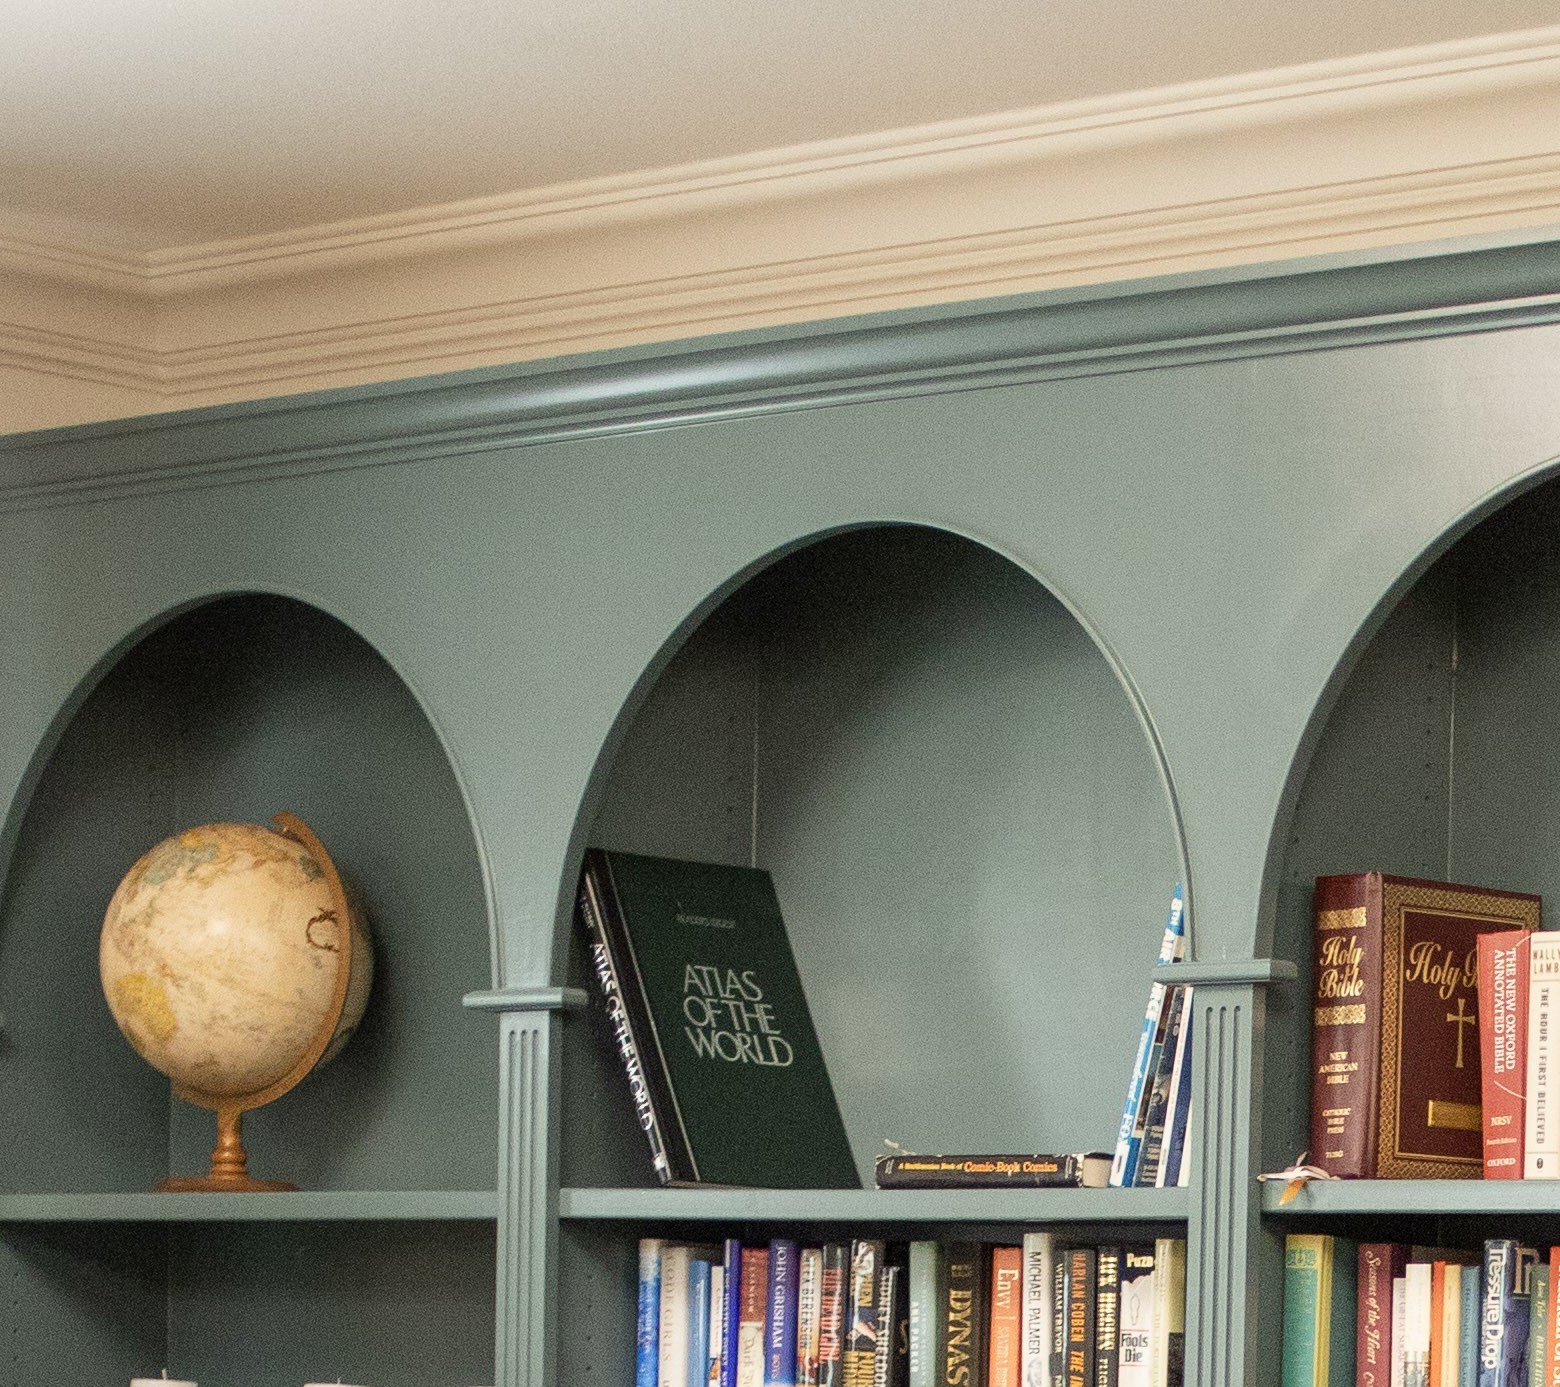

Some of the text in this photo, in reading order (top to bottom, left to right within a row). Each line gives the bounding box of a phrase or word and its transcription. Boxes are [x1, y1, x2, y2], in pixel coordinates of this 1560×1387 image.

[1322, 936, 1364, 970] Holy
[1406, 940, 1466, 1000] Holy
[1534, 963, 1560, 974] LAMB
[683, 963, 763, 1001] ATLAS
[1318, 963, 1364, 998] Bible
[1539, 988, 1550, 1008] THE
[683, 995, 781, 1034] OF THE
[1493, 949, 1506, 1074] ANNOTATED BIBLE
[1504, 947, 1517, 1070] THE NEW OXFORD
[1538, 1013, 1550, 1042] HOUR
[590, 943, 618, 996] ATLAS
[624, 1057, 656, 1131] WORLD
[685, 1026, 794, 1067] WORLD
[1330, 1051, 1349, 1061] NEW
[1318, 1062, 1359, 1073] AMERICAN
[1537, 1055, 1548, 1087] FIRST
[1535, 1091, 1547, 1145] BELIEVED
[963, 1161, 1058, 1173] Comic-Book Comics
[995, 1268, 1020, 1310] Envy
[1028, 1251, 1043, 1303] MICHAEL
[1071, 1251, 1087, 1299] HARLAN
[1098, 1253, 1119, 1287] JACK
[771, 1245, 788, 1349] JOHN GRISHAM
[1027, 1307, 1042, 1356] PALMER
[1071, 1302, 1087, 1342] COBEN
[1097, 1292, 1118, 1351] HIGGINS
[1122, 1333, 1149, 1348] Fools
[1069, 1350, 1086, 1373] THE
[1124, 1349, 1143, 1363] Die
